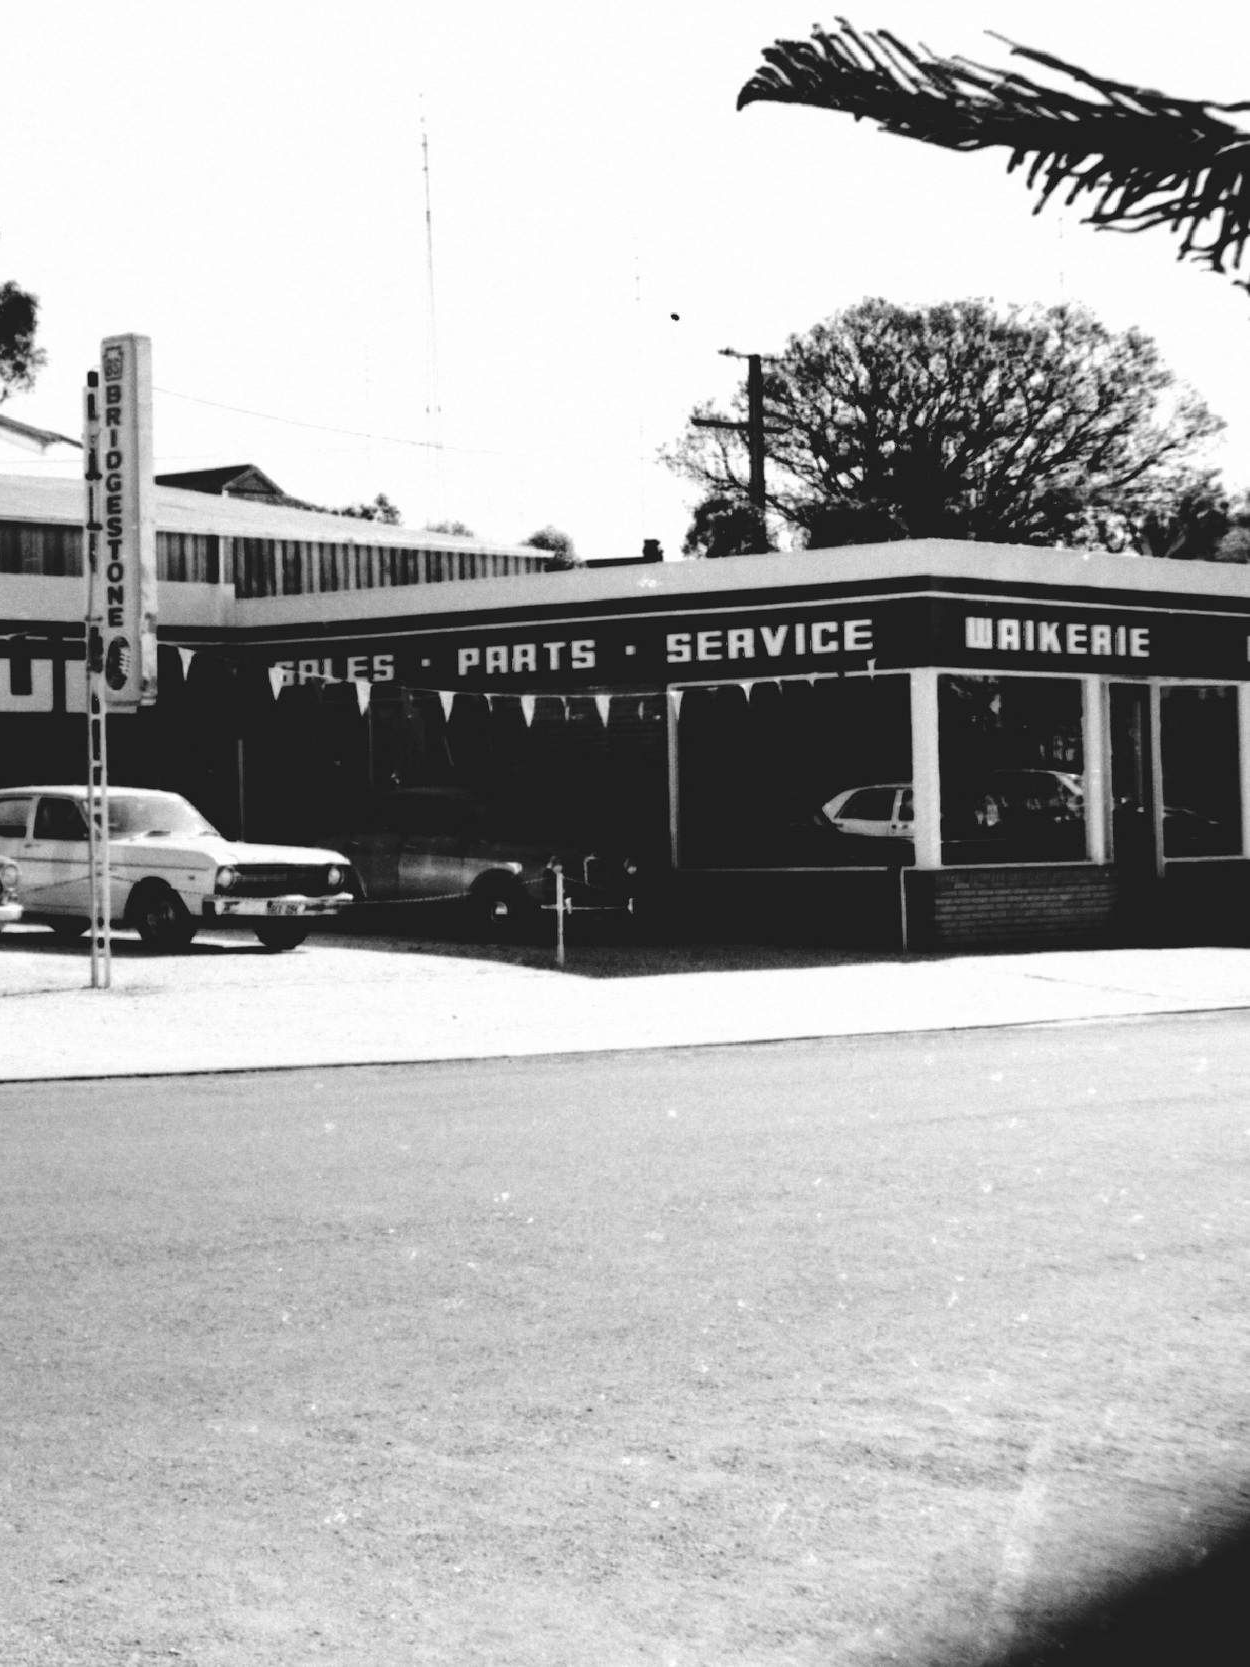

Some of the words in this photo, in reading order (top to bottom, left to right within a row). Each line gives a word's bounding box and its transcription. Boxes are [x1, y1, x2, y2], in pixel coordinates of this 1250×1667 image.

[105, 384, 124, 628] BRIDGESTONE
[270, 653, 395, 687] SALES
[457, 639, 597, 676] PARTS
[666, 618, 873, 663] SERVICE
[964, 616, 1150, 658] WAIKERIE
